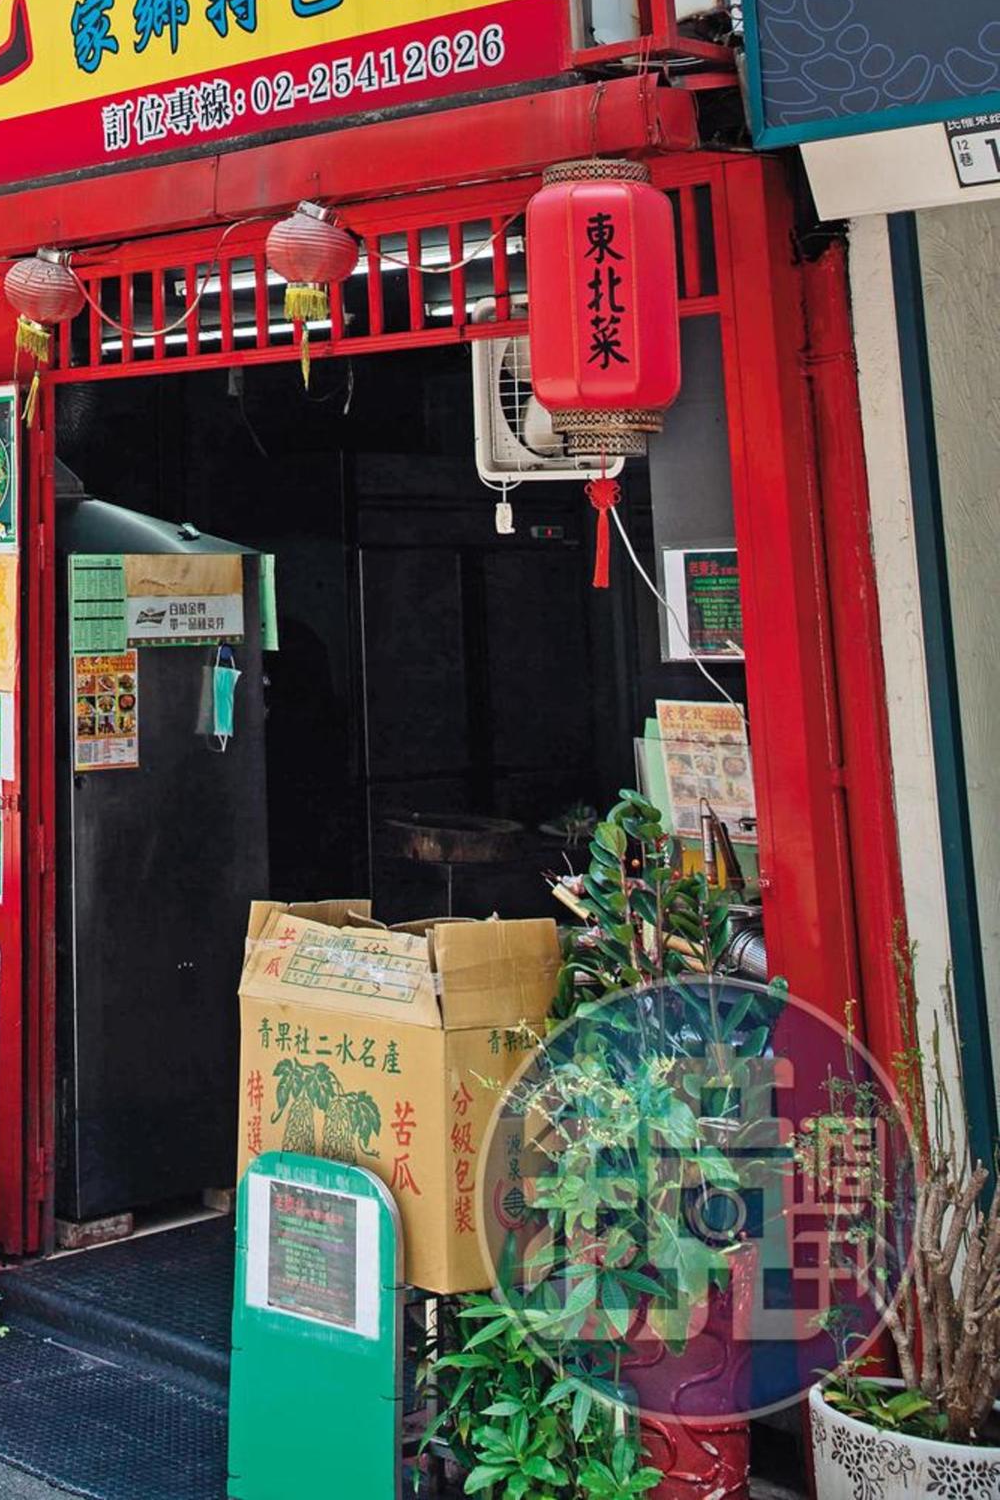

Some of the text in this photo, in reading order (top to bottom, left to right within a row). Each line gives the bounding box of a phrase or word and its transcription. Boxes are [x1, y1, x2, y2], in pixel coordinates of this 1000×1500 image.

[582, 211, 631, 370] 東北菜
[256, 1015, 403, 1077] 青果社二水名產
[246, 1069, 265, 1156] 特選
[389, 1100, 422, 1197] 苦瓜
[451, 1080, 477, 1234] 分級包裝
